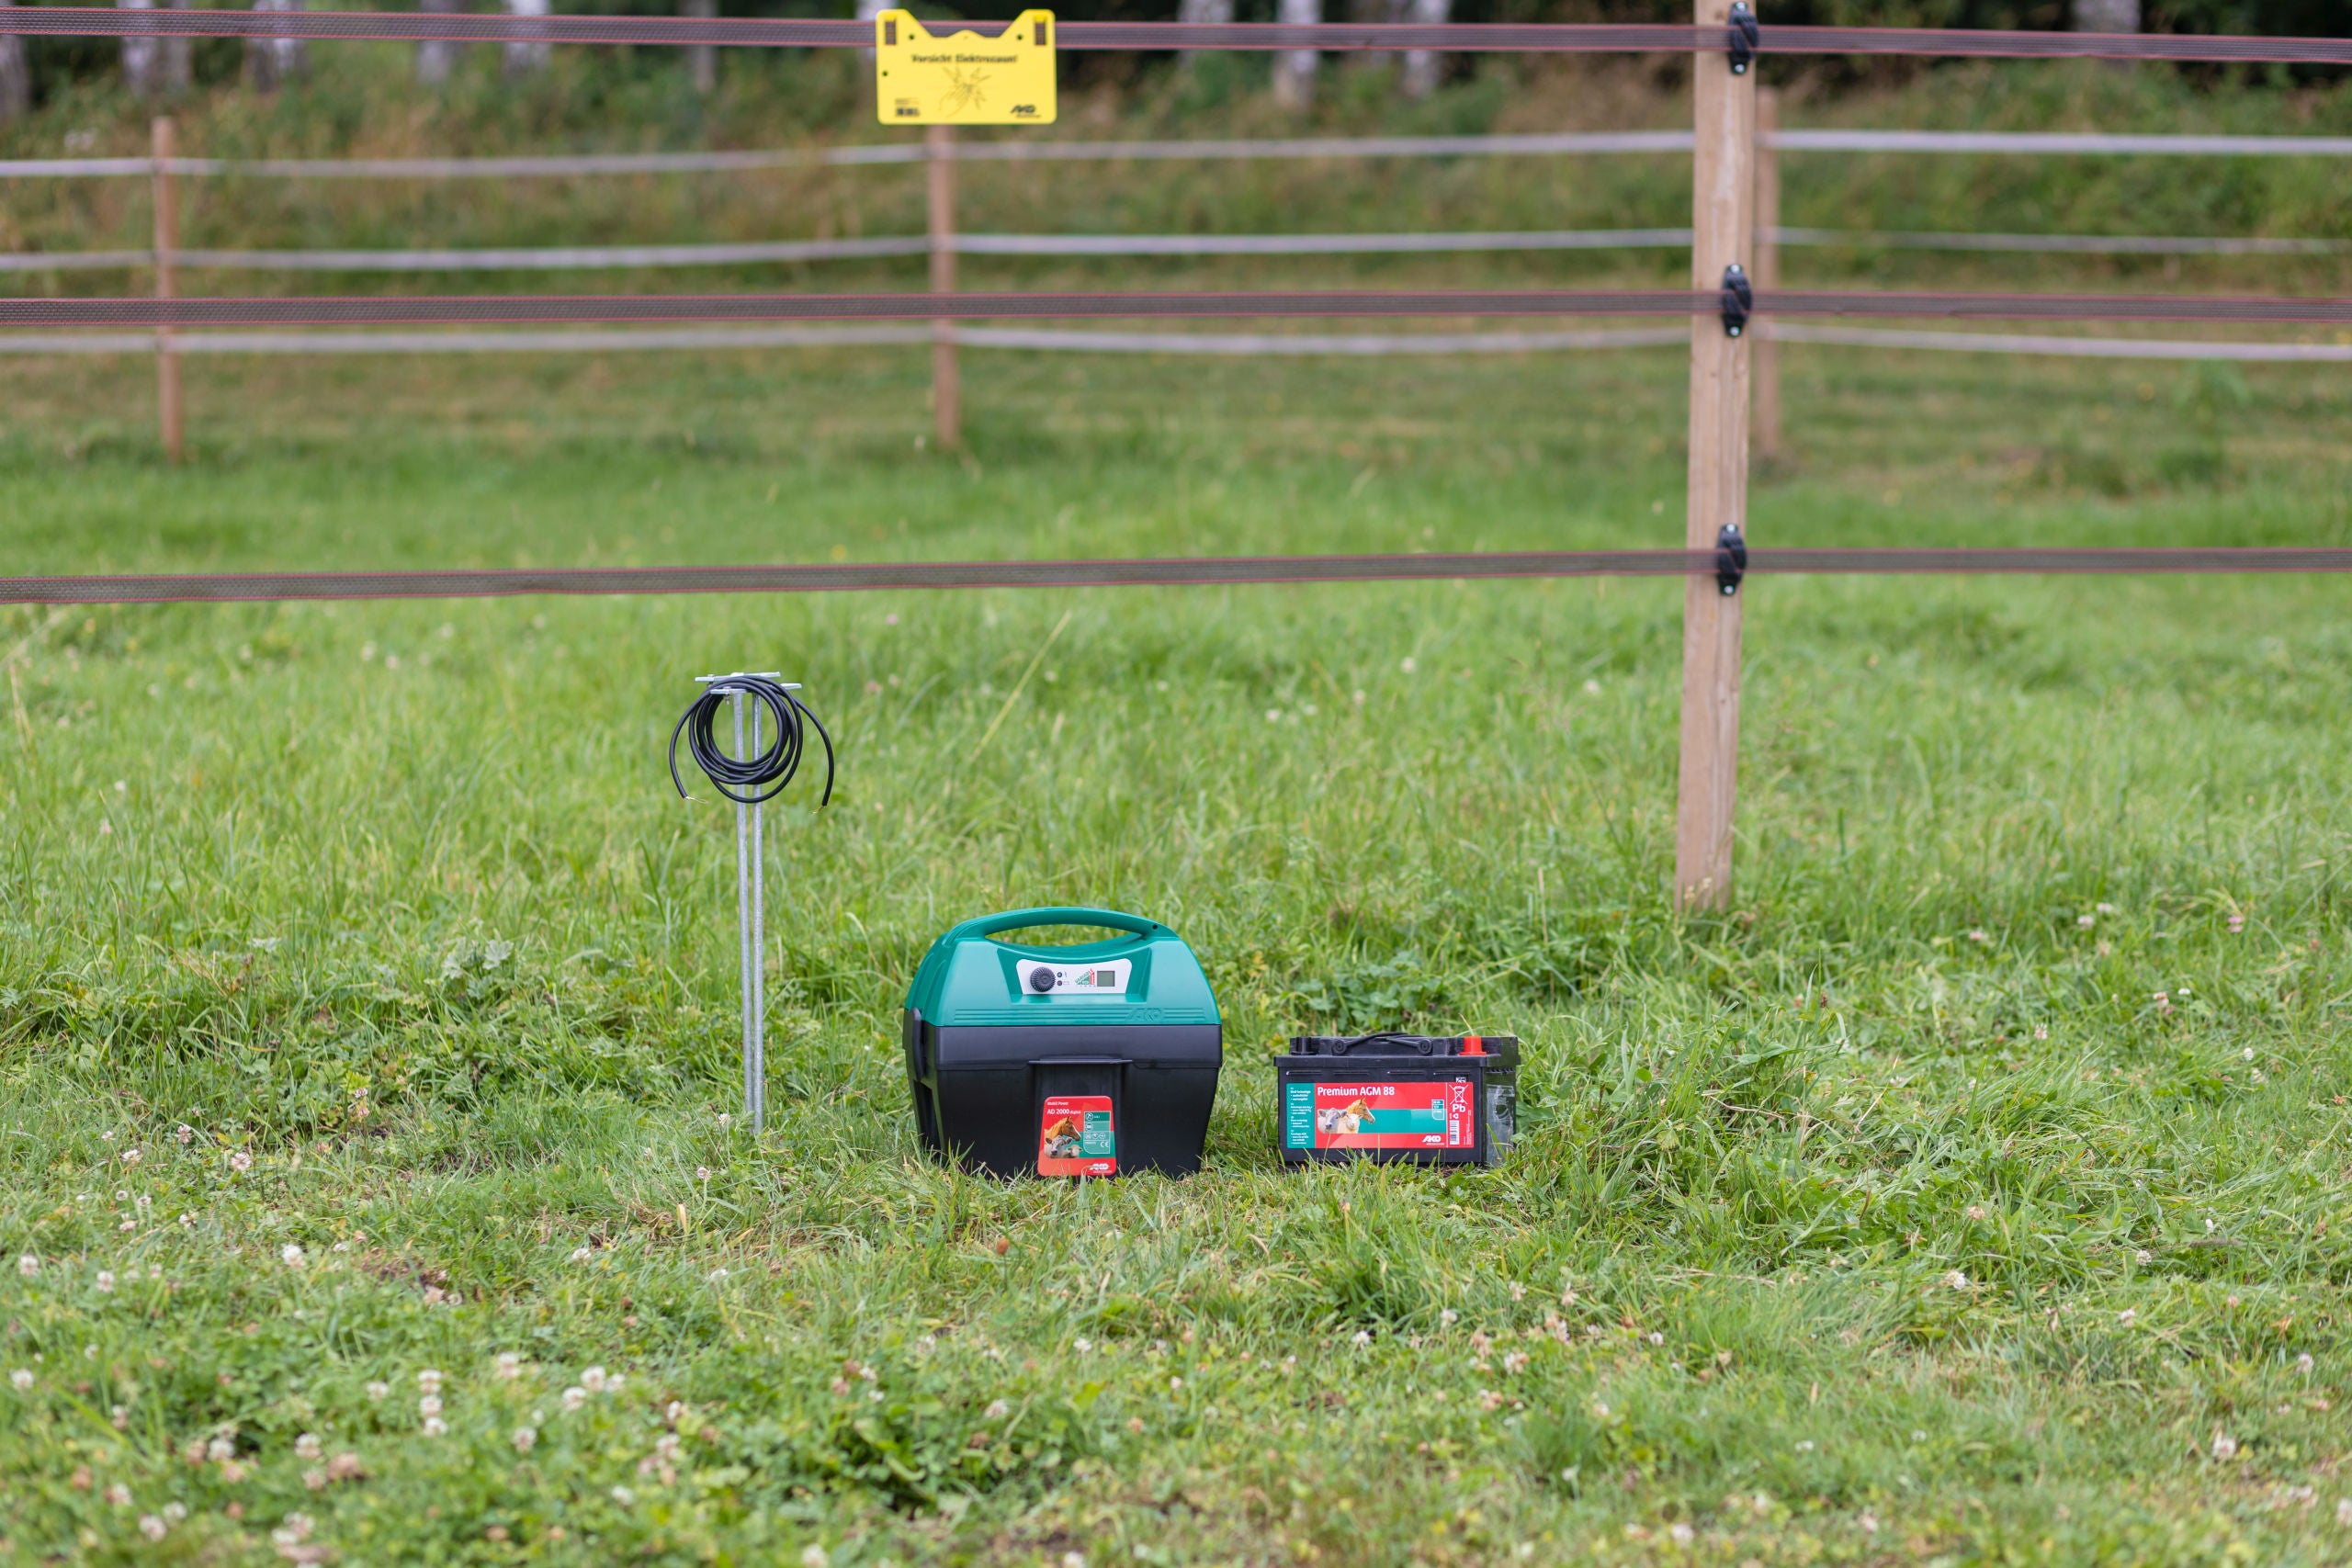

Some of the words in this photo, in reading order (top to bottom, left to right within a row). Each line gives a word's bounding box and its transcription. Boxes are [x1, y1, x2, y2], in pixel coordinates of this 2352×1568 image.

[1317, 1086, 1358, 1096] Premium
[1360, 1086, 1381, 1096] AGM
[1383, 1086, 1395, 1096] 88
[1452, 1104, 1465, 1112] Pb
